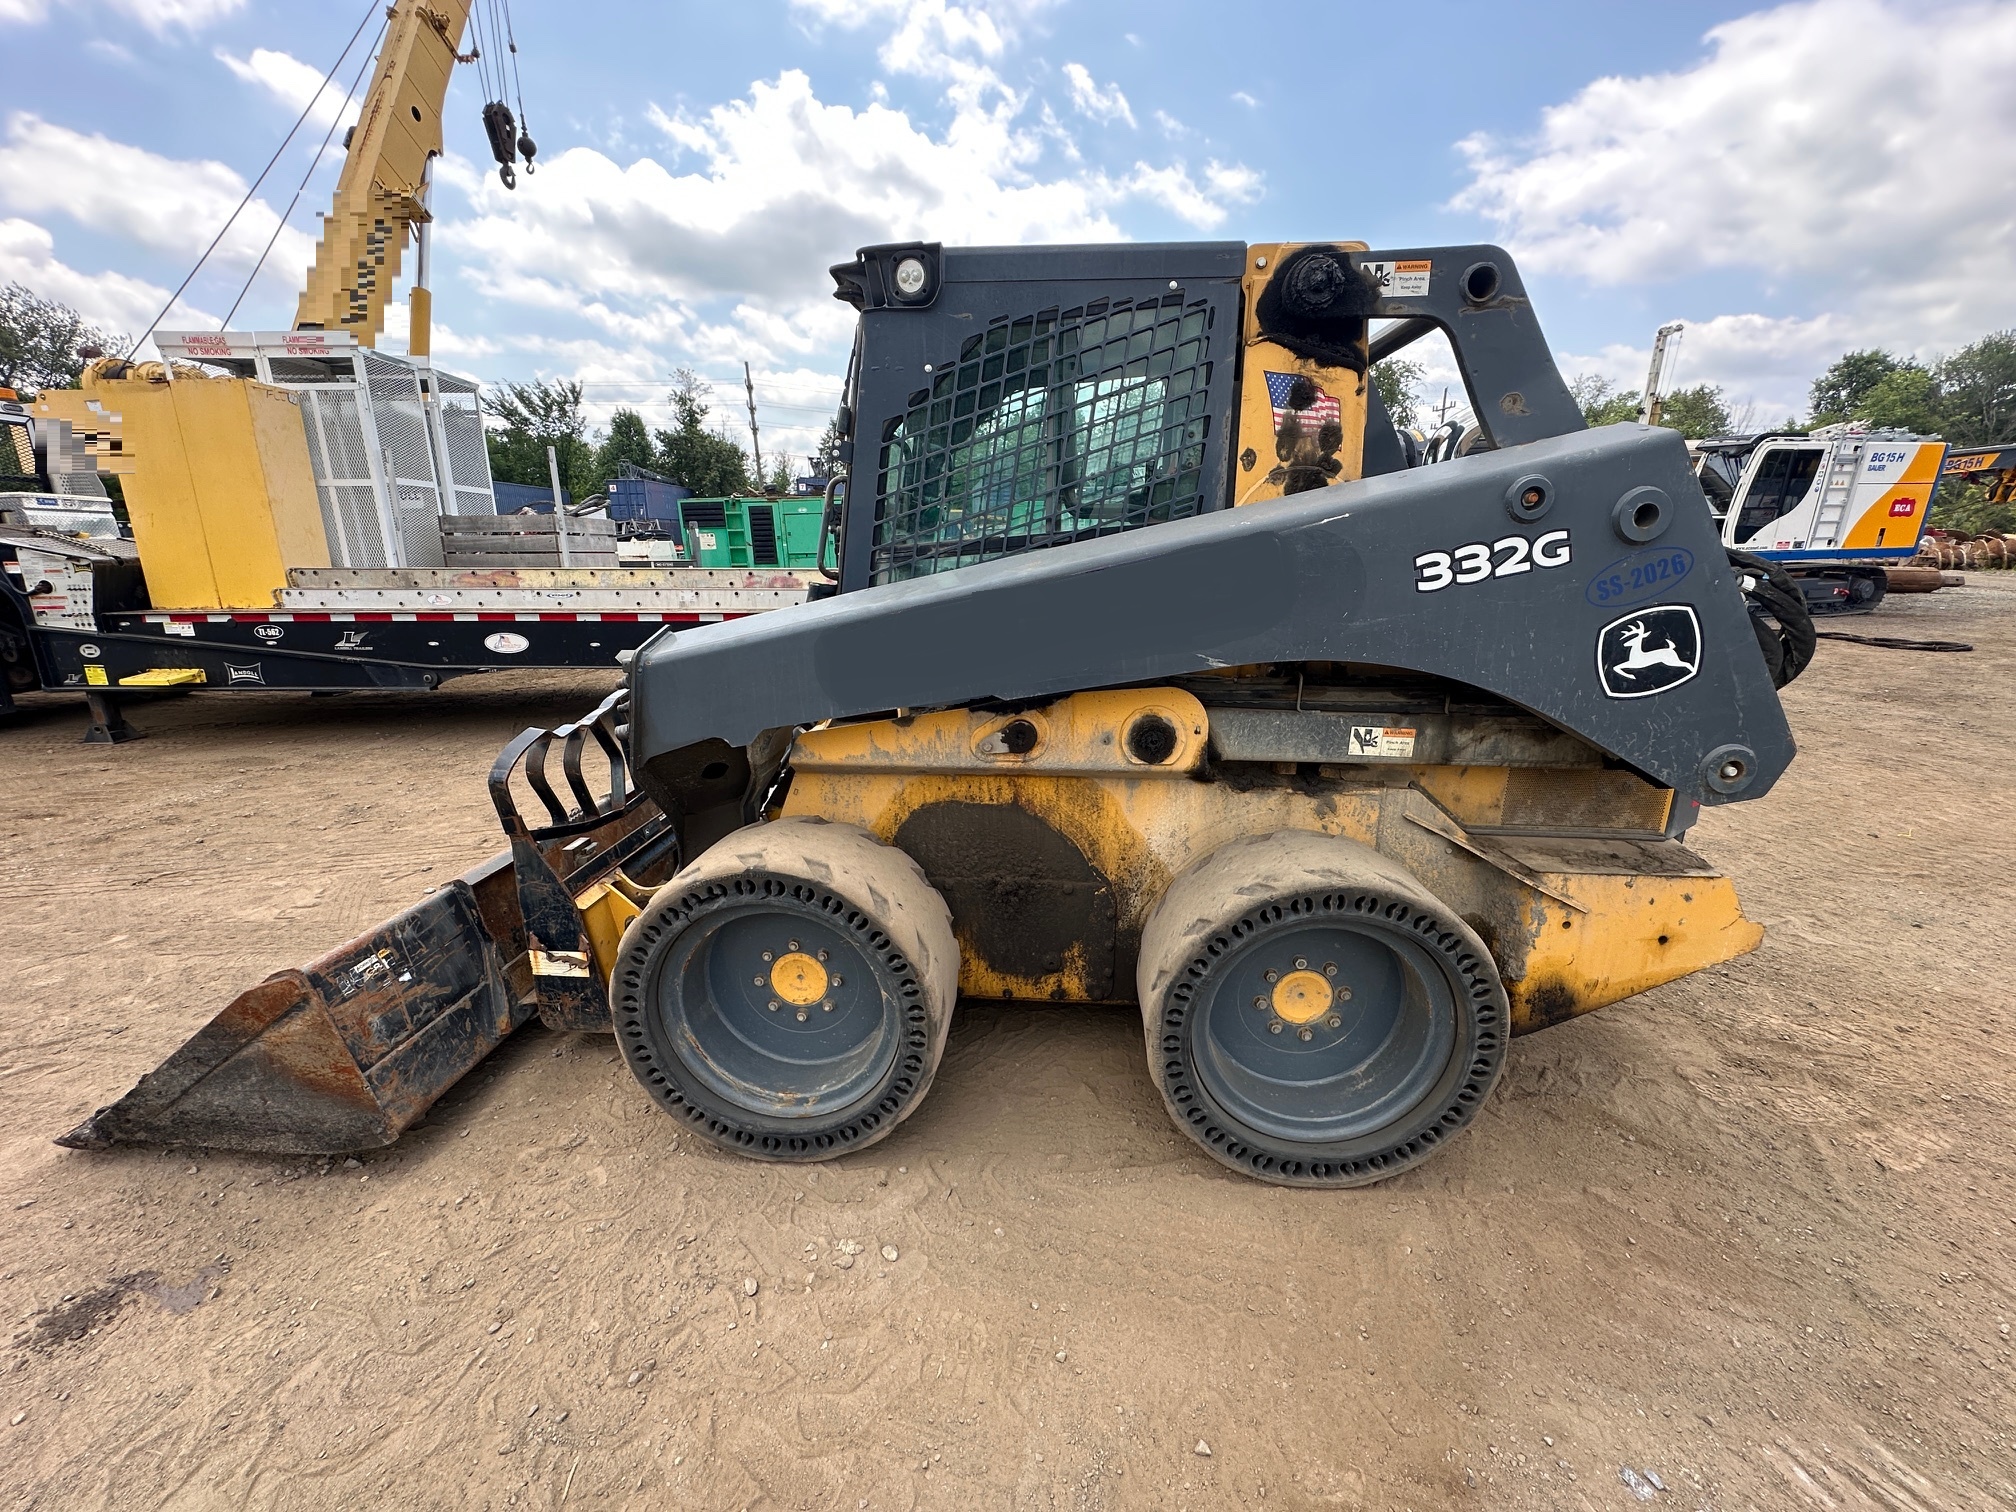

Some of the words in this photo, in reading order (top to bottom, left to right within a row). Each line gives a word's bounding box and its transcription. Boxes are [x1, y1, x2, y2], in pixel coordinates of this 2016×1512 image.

[181, 336, 213, 345] FLAMMABLE
[213, 337, 226, 346] GAS
[187, 347, 198, 356] NO
[200, 347, 231, 356] SMOKING
[287, 346, 297, 355] NO
[1867, 464, 1887, 472] BAUER
[1893, 503, 1911, 513] ECA
[1414, 530, 1571, 592] 332G
[1596, 553, 1686, 601] SS-2026
[257, 628, 280, 636] TL-562
